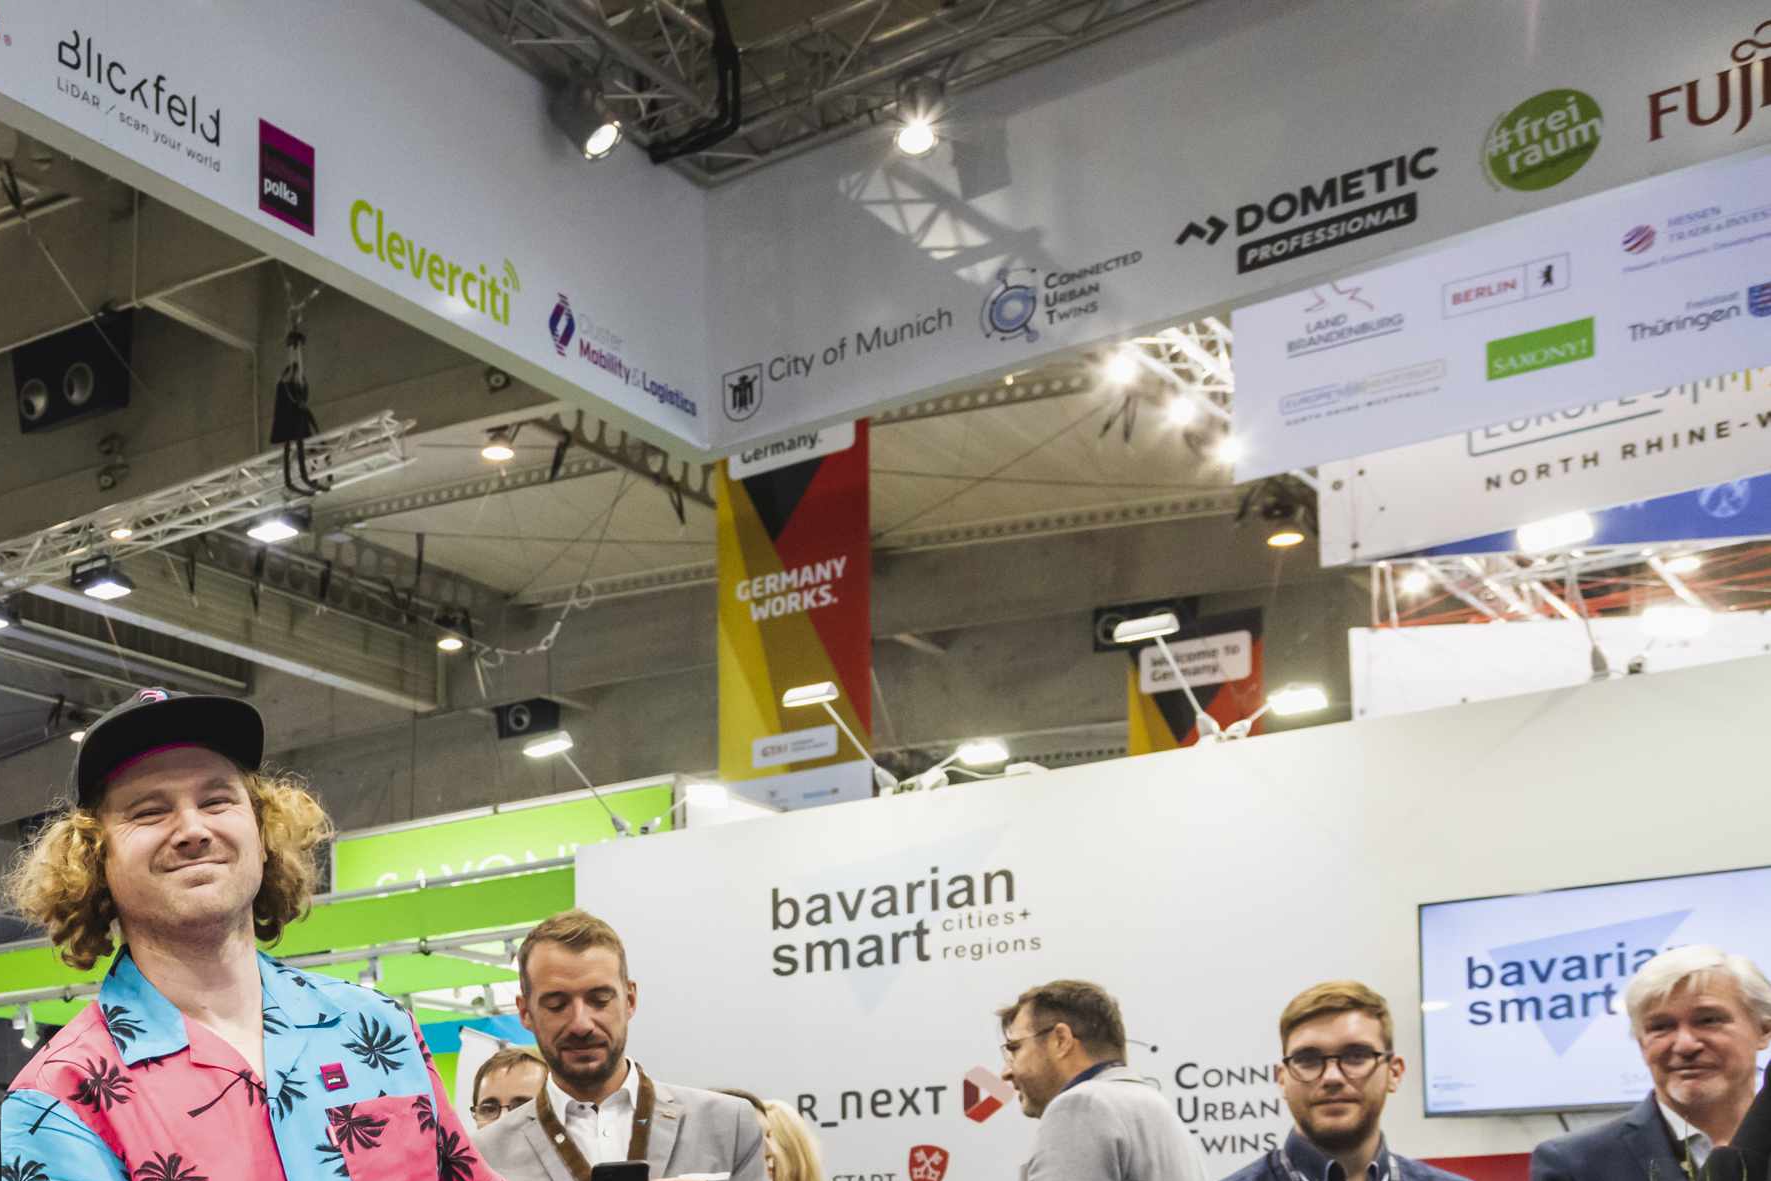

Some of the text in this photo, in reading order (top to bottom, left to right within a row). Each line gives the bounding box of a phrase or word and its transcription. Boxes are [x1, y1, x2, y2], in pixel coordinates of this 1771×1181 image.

[57, 30, 221, 147] Blickfeld
[119, 112, 149, 135] scan
[152, 128, 181, 152] your
[185, 147, 221, 173] world
[1508, 118, 1600, 174] raum
[264, 178, 298, 207] polka
[1236, 146, 1438, 236] DOMETIC
[1245, 203, 1409, 266] PROFESSIONAL
[349, 198, 511, 326] Cleverciti
[1451, 278, 1517, 305] BERLIN
[1287, 313, 1404, 352] BRANDENBURG
[1305, 313, 1347, 334] LAND
[1628, 304, 1741, 341] Thüringen
[768, 308, 953, 382] City of Munich
[1485, 451, 1600, 491] NORTH
[735, 556, 847, 602] GERMANY
[750, 584, 838, 622] WORKS.
[771, 866, 1015, 931] bavarian
[771, 908, 1032, 977] smart cities+
[941, 935, 1042, 961] regions
[1467, 942, 1658, 989] bavaria
[1468, 983, 1618, 1026] smart
[1174, 1062, 1278, 1090] CONN
[1176, 1096, 1280, 1123] URBAN
[1189, 1129, 1278, 1155] WINS
